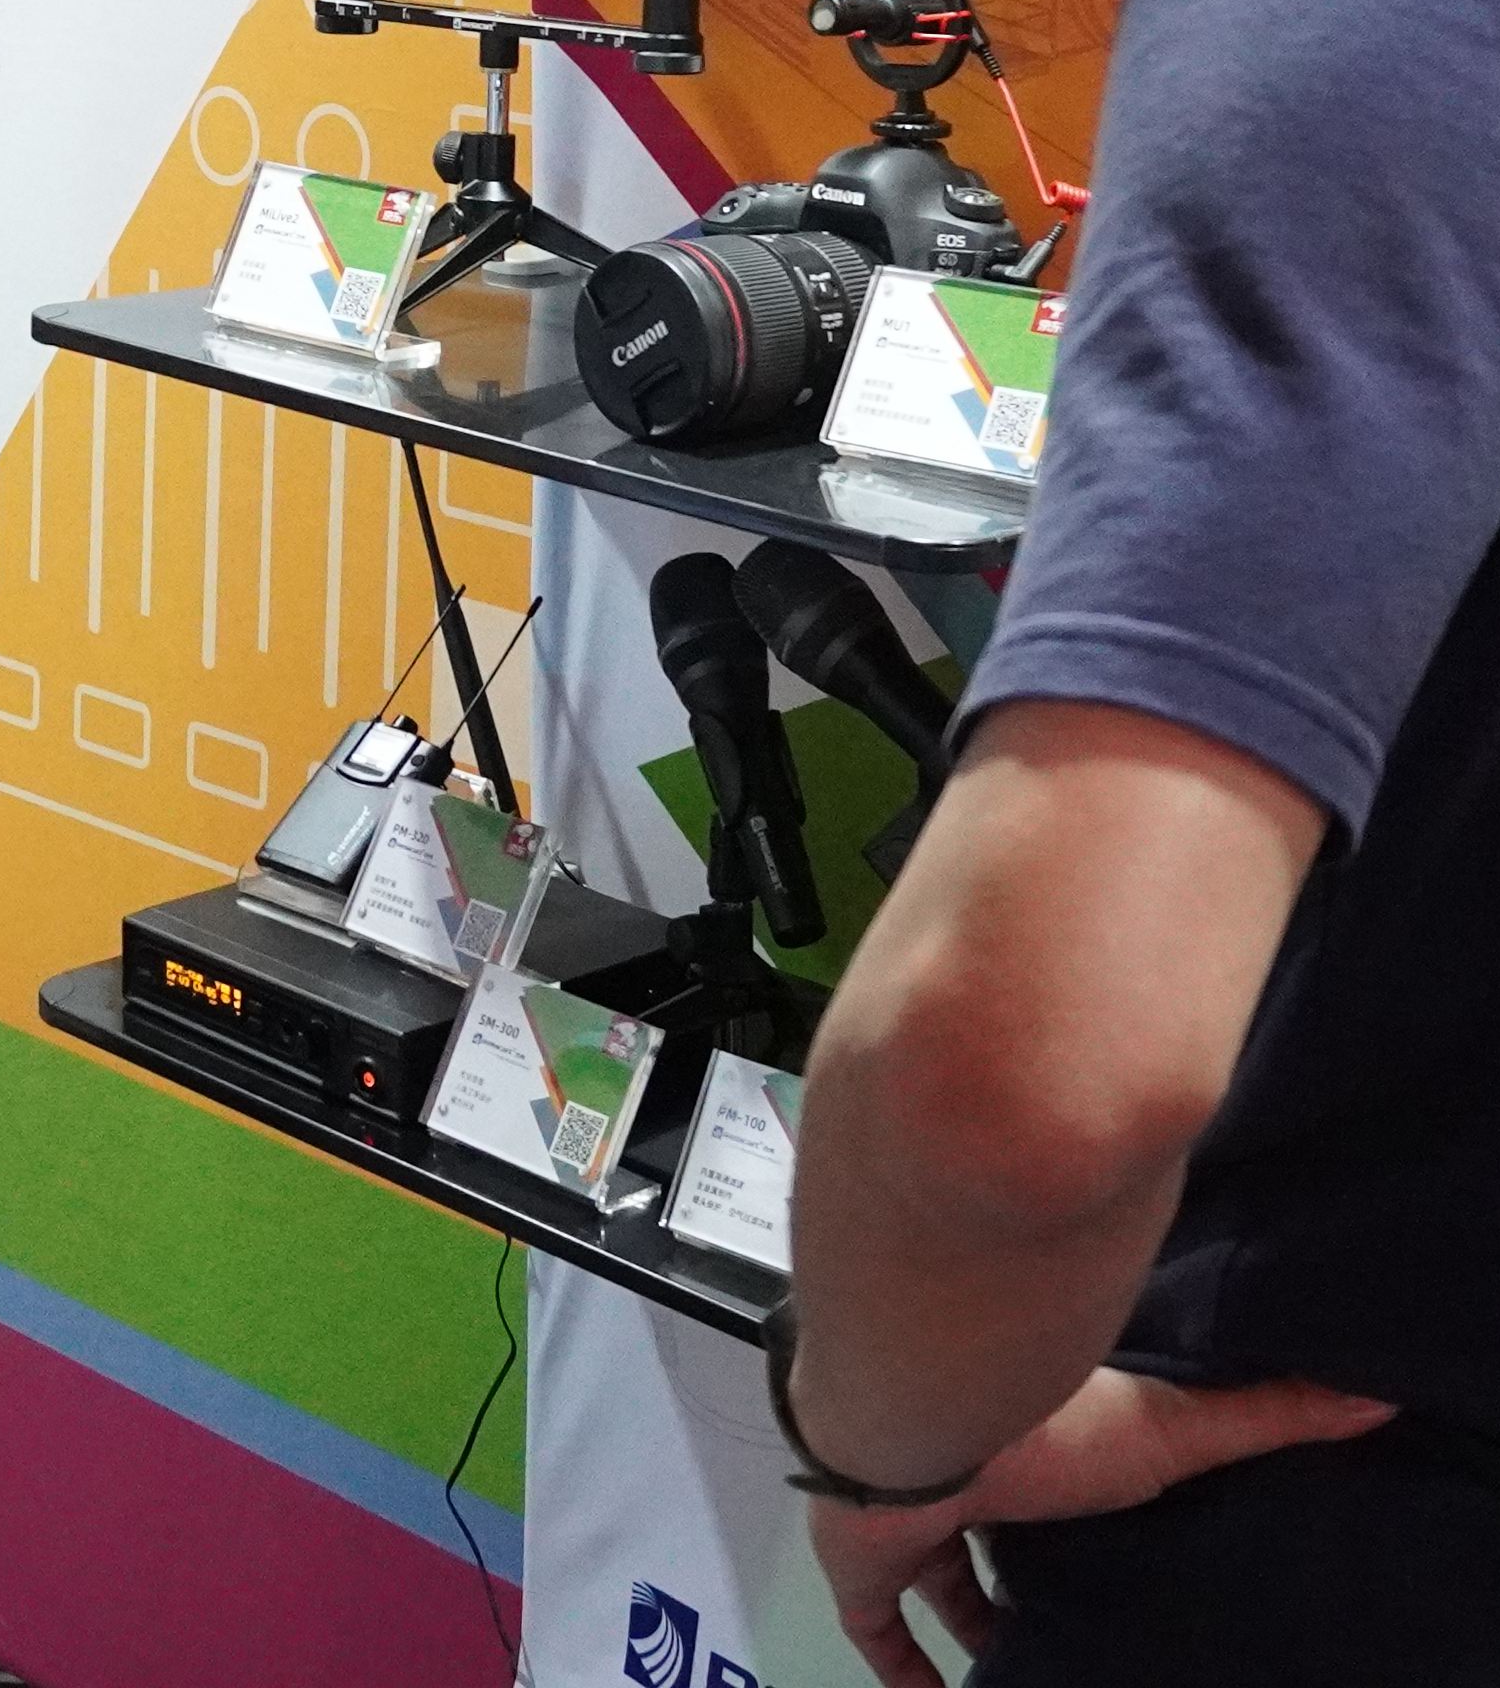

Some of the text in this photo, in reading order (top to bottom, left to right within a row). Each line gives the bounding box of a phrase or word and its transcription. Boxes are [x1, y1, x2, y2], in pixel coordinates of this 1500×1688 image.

[811, 183, 866, 207] Canon
[936, 233, 967, 248] EOS
[611, 319, 670, 368] Canon
[478, 1014, 521, 1040] SM-300
